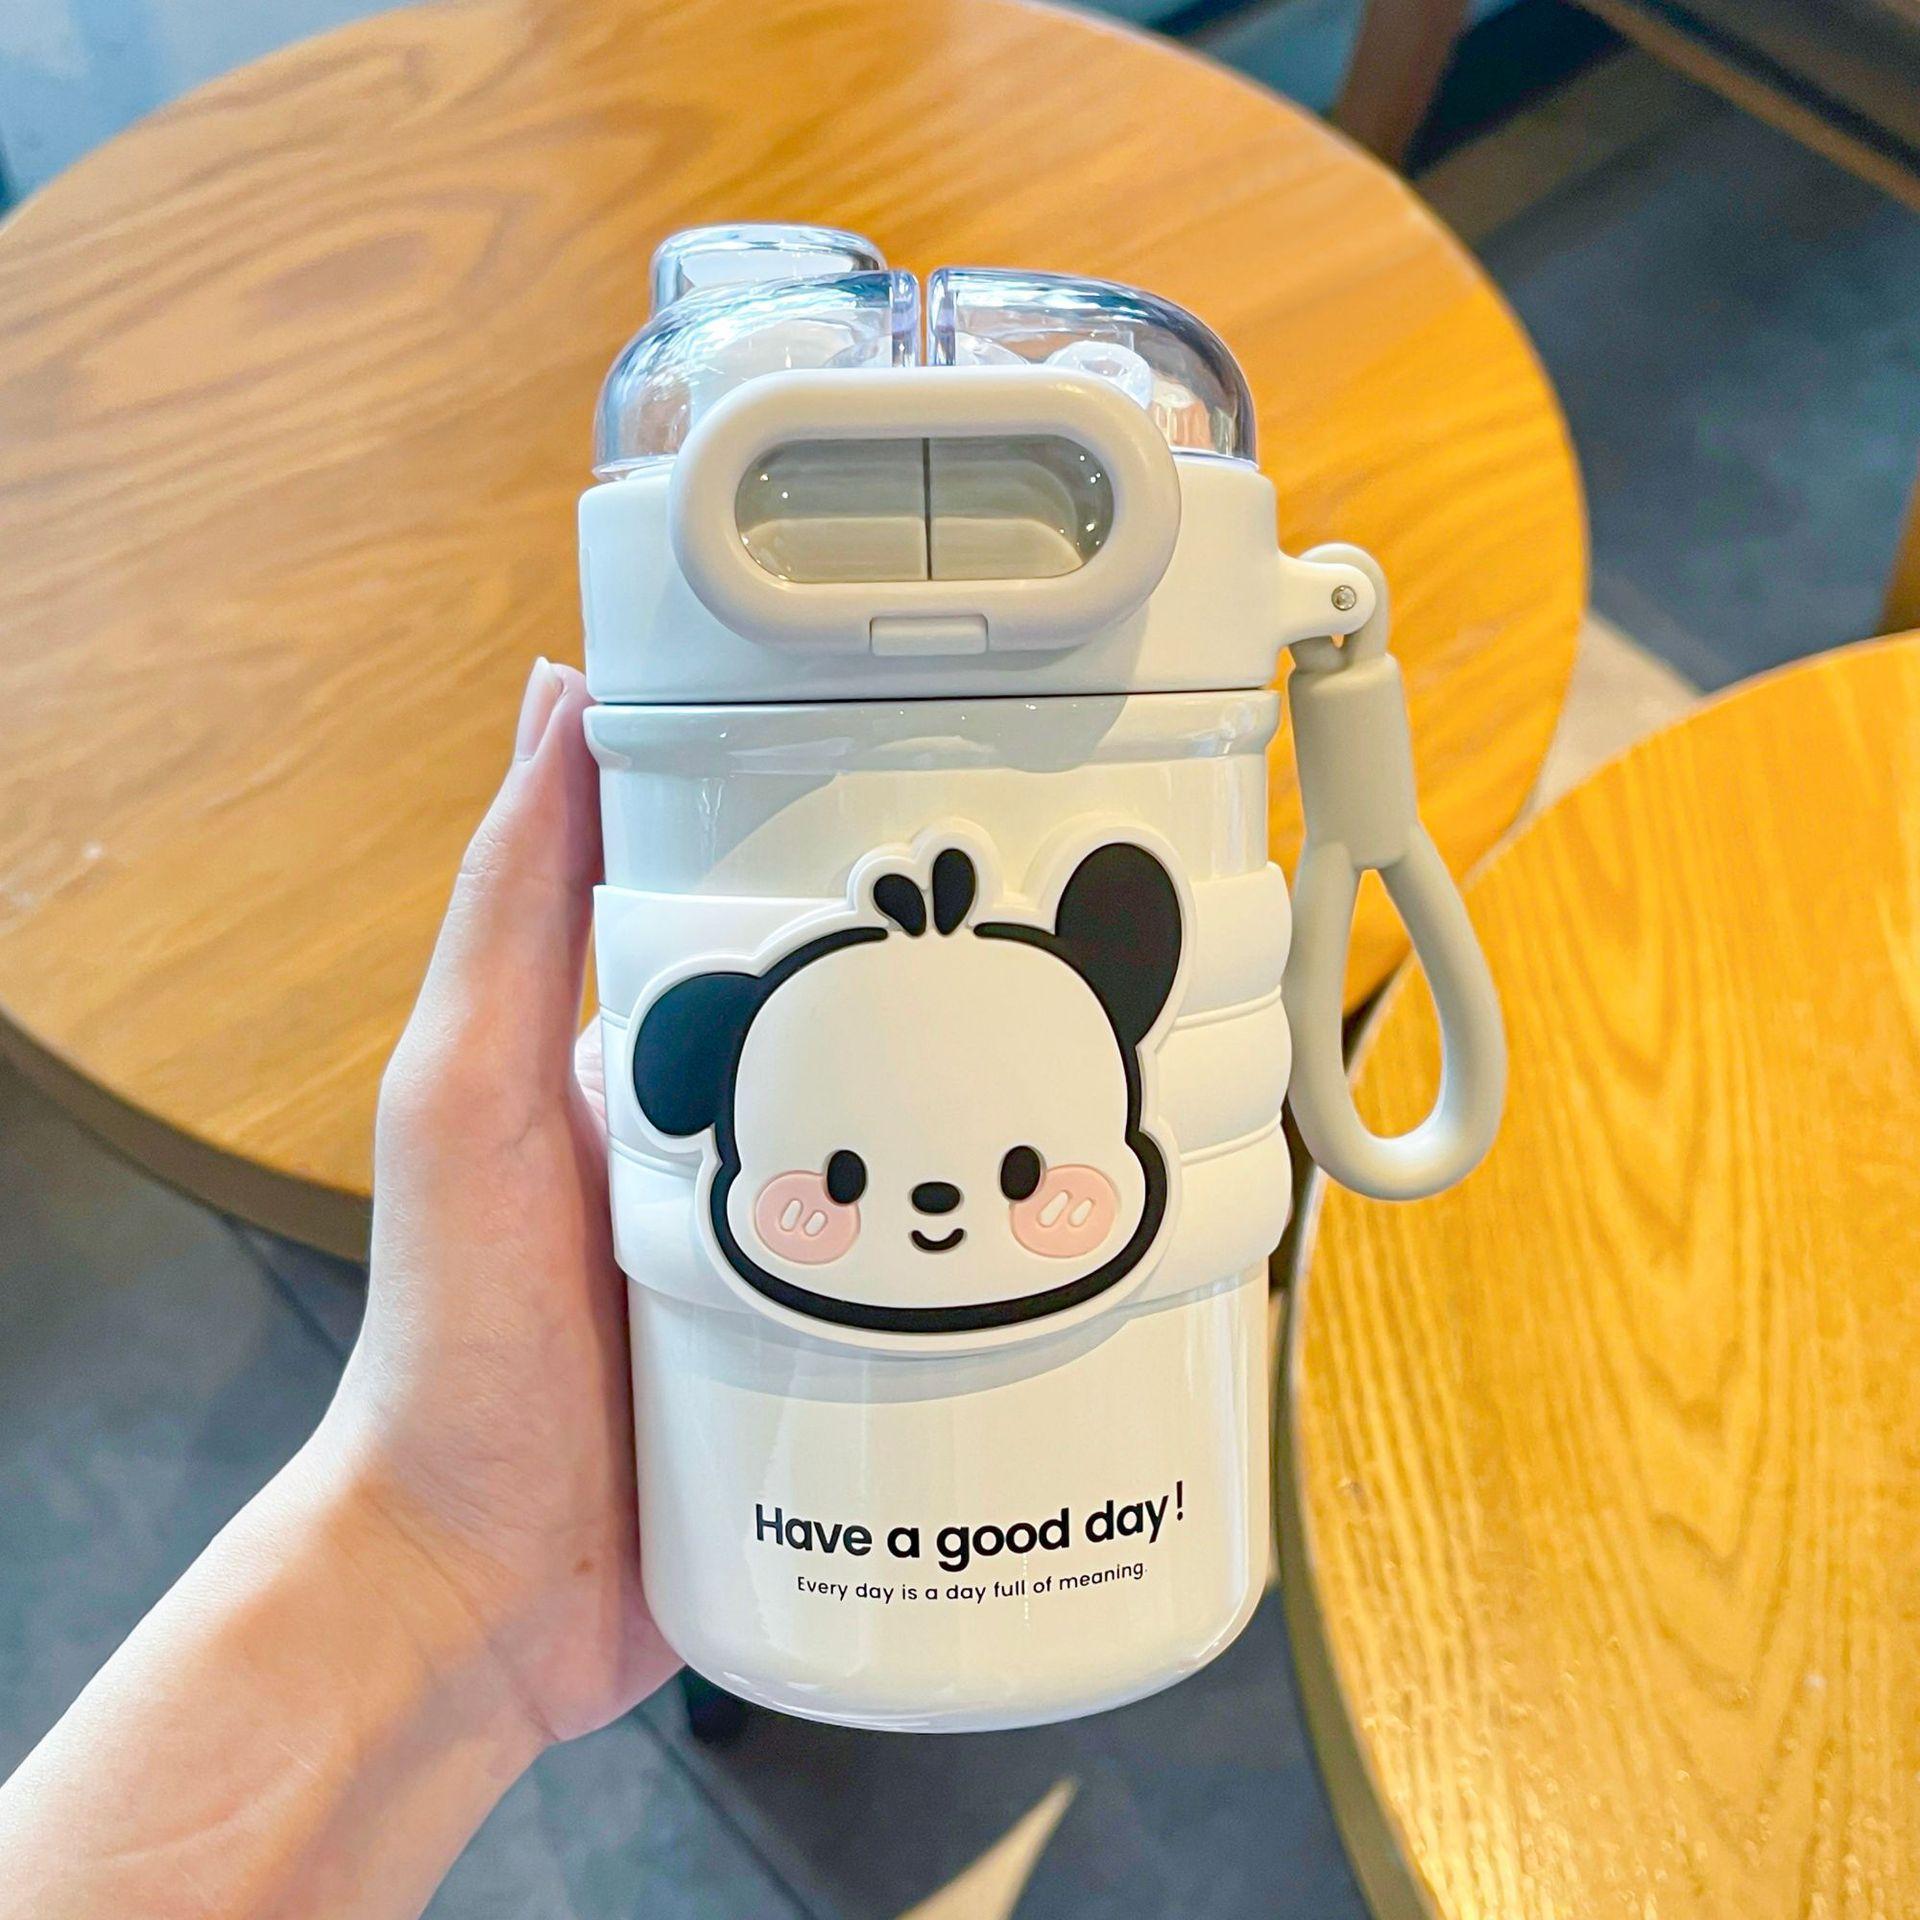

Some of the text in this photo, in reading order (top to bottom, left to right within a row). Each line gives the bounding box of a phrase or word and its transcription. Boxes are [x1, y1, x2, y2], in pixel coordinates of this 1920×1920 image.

[754, 1502, 873, 1558] Have
[886, 1525, 921, 1559] a
[936, 1507, 1070, 1573] good
[797, 1575, 849, 1602] Every
[855, 1582, 895, 1605] day
[901, 1584, 918, 1600] is
[924, 1587, 938, 1600] a
[945, 1584, 987, 1605] day
[993, 1579, 1026, 1598] full
[1032, 1575, 1052, 1594] of
